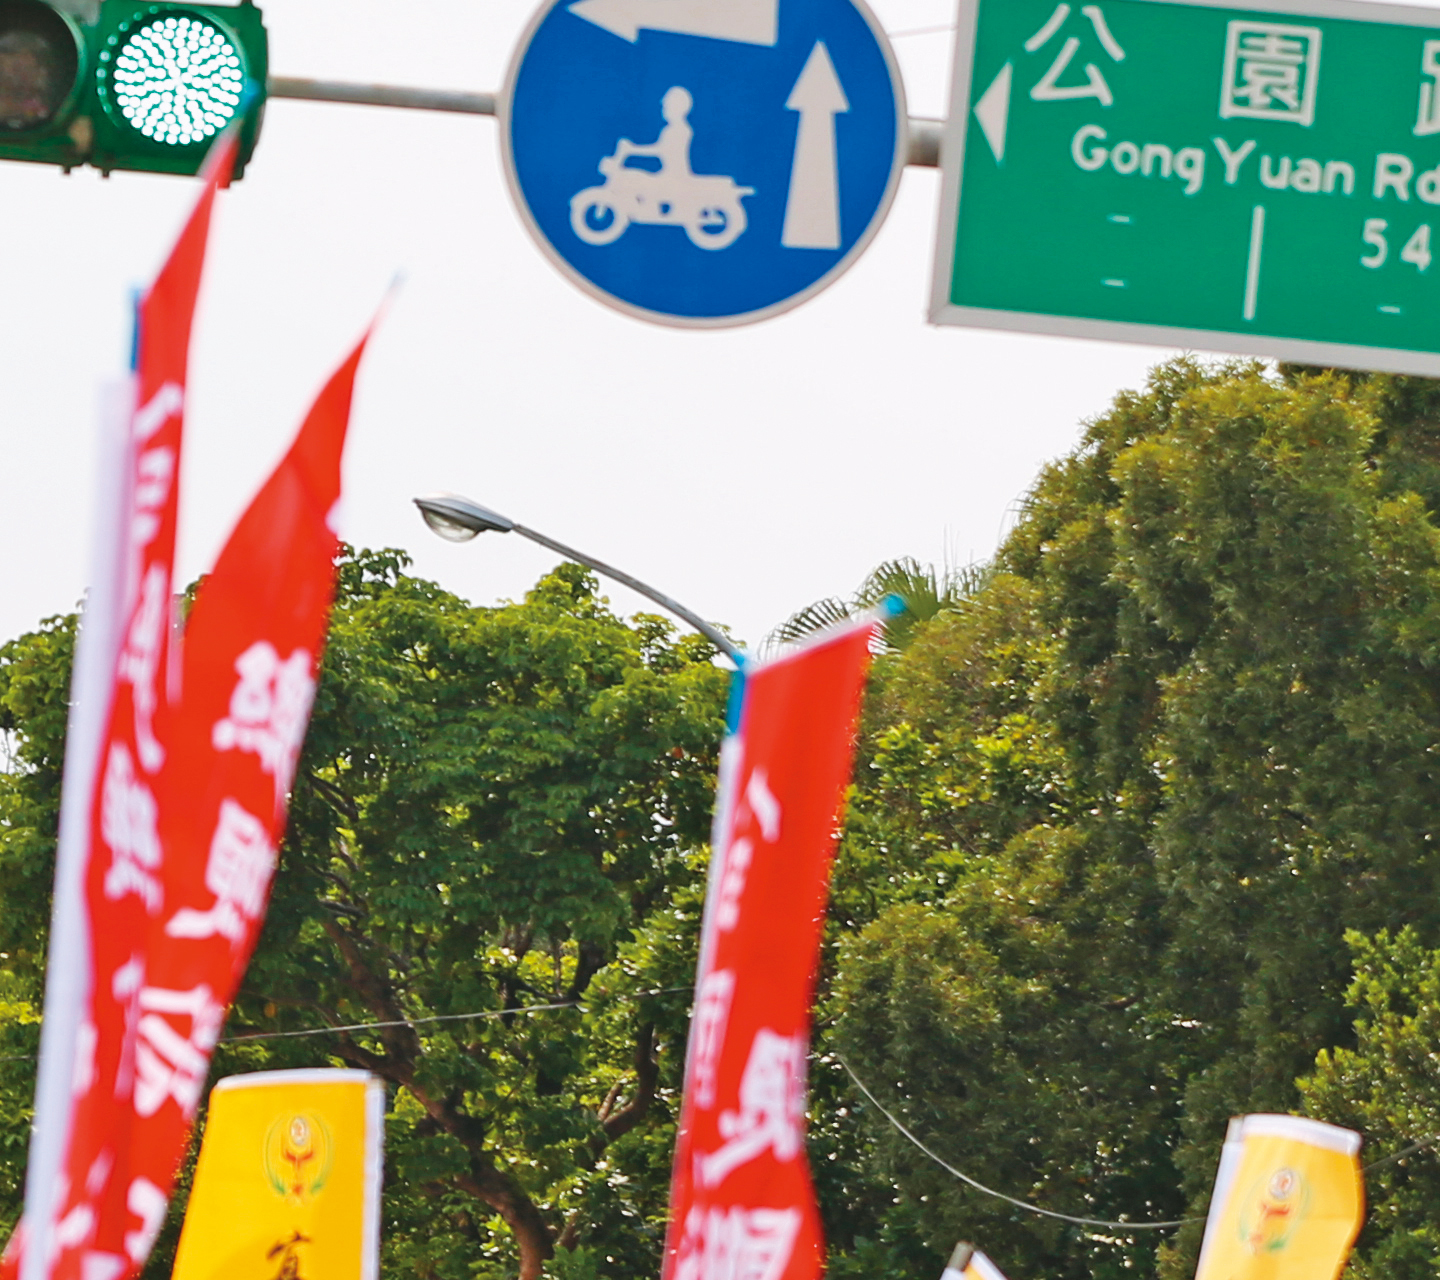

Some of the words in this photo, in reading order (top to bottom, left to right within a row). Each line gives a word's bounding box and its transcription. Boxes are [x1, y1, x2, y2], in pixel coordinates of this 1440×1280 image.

[1023, 3, 1440, 137] 公園
[1070, 123, 1356, 197] GongYuan
[1360, 217, 1432, 272] 54
